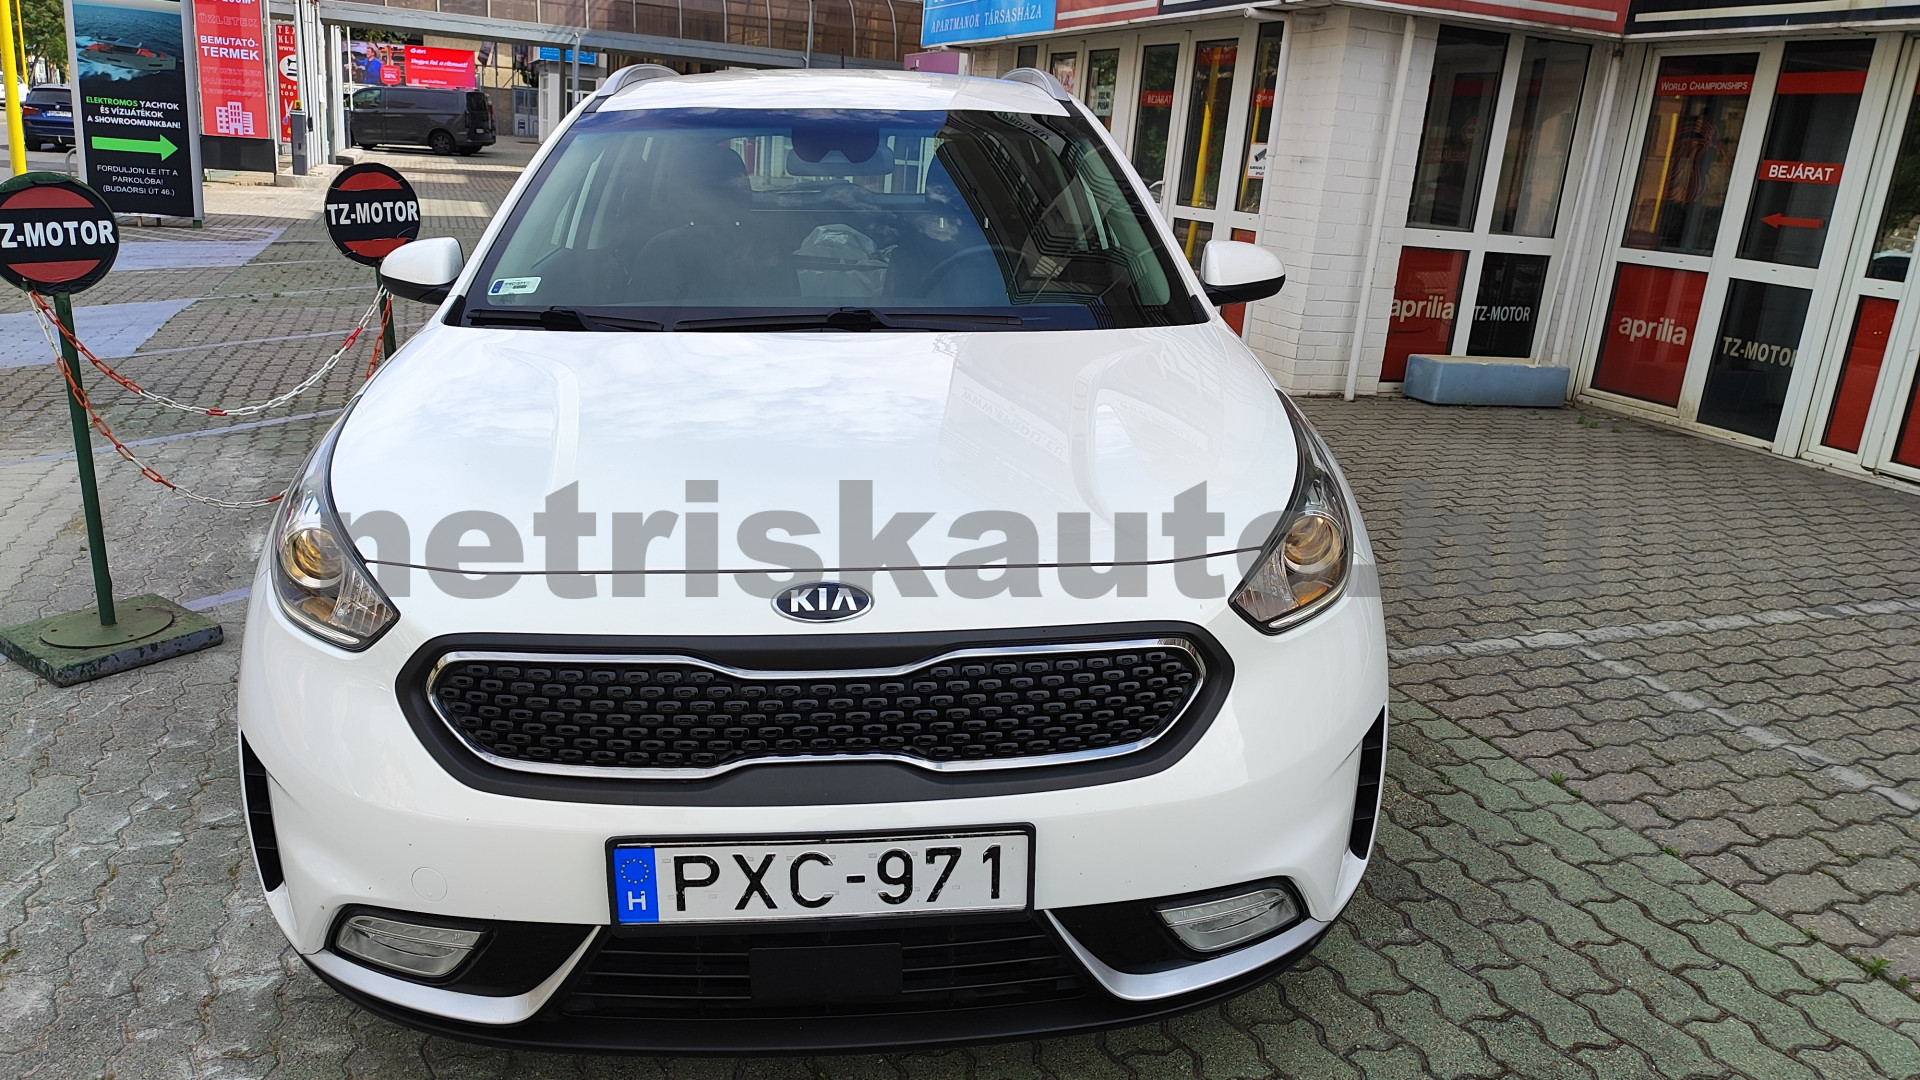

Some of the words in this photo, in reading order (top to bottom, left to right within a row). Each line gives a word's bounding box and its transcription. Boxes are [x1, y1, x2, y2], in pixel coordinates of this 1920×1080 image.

[930, 14, 980, 33] APARTMANOK
[984, 4, 1042, 26] TÁRSASHÁZA
[200, 35, 259, 48] BEMUTATÓ-
[201, 45, 260, 61] TERMEK
[85, 96, 138, 107] ELEKTROMOS
[139, 100, 180, 111] YACHTOK
[100, 105, 109, 114] ÉS
[94, 116, 181, 129] SHOWROOMUNKBAN!
[97, 164, 145, 175] FORDULJON
[158, 168, 171, 176] ITT
[1769, 163, 1835, 182] BEJÁRAT
[112, 175, 164, 185] PARKOLÓBA!
[327, 201, 419, 225] TZ-MOTOR
[0, 220, 116, 249] Z-MOTOR
[1391, 295, 1455, 323] aprilia
[1473, 305, 1531, 322] TZ-MOTOR
[1618, 317, 1688, 346] aprilia
[790, 587, 857, 612] KIA
[628, 891, 647, 911] H
[673, 844, 1001, 912] PXC-971
